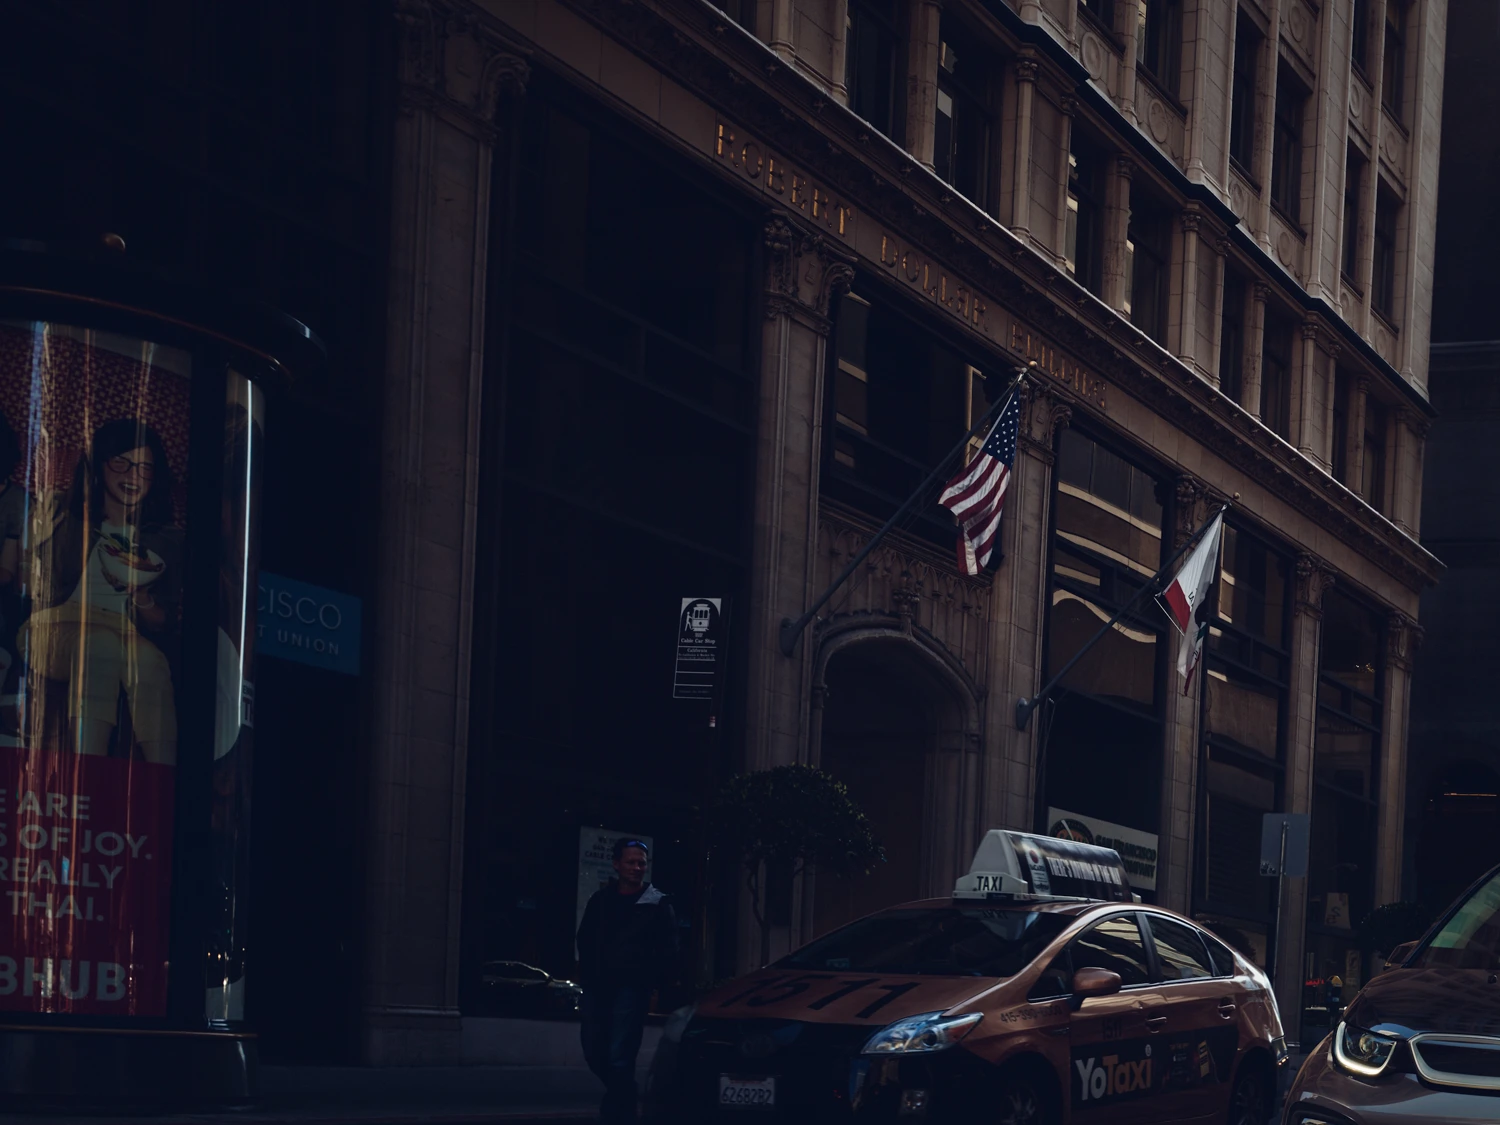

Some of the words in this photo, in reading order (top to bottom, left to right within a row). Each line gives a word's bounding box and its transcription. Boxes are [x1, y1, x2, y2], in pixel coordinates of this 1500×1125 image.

[716, 122, 855, 237] ROBERT
[879, 233, 990, 332] DOLLAR
[278, 629, 338, 655] UNION
[16, 790, 92, 821] ARE
[18, 823, 71, 852] OF
[80, 829, 153, 860] JOY.
[976, 875, 1003, 891] TAXI
[5, 890, 105, 922] THAI.
[719, 974, 922, 1019] 1511
[1102, 1016, 1123, 1041] 1511
[1075, 1044, 1152, 1101] YoTaxi
